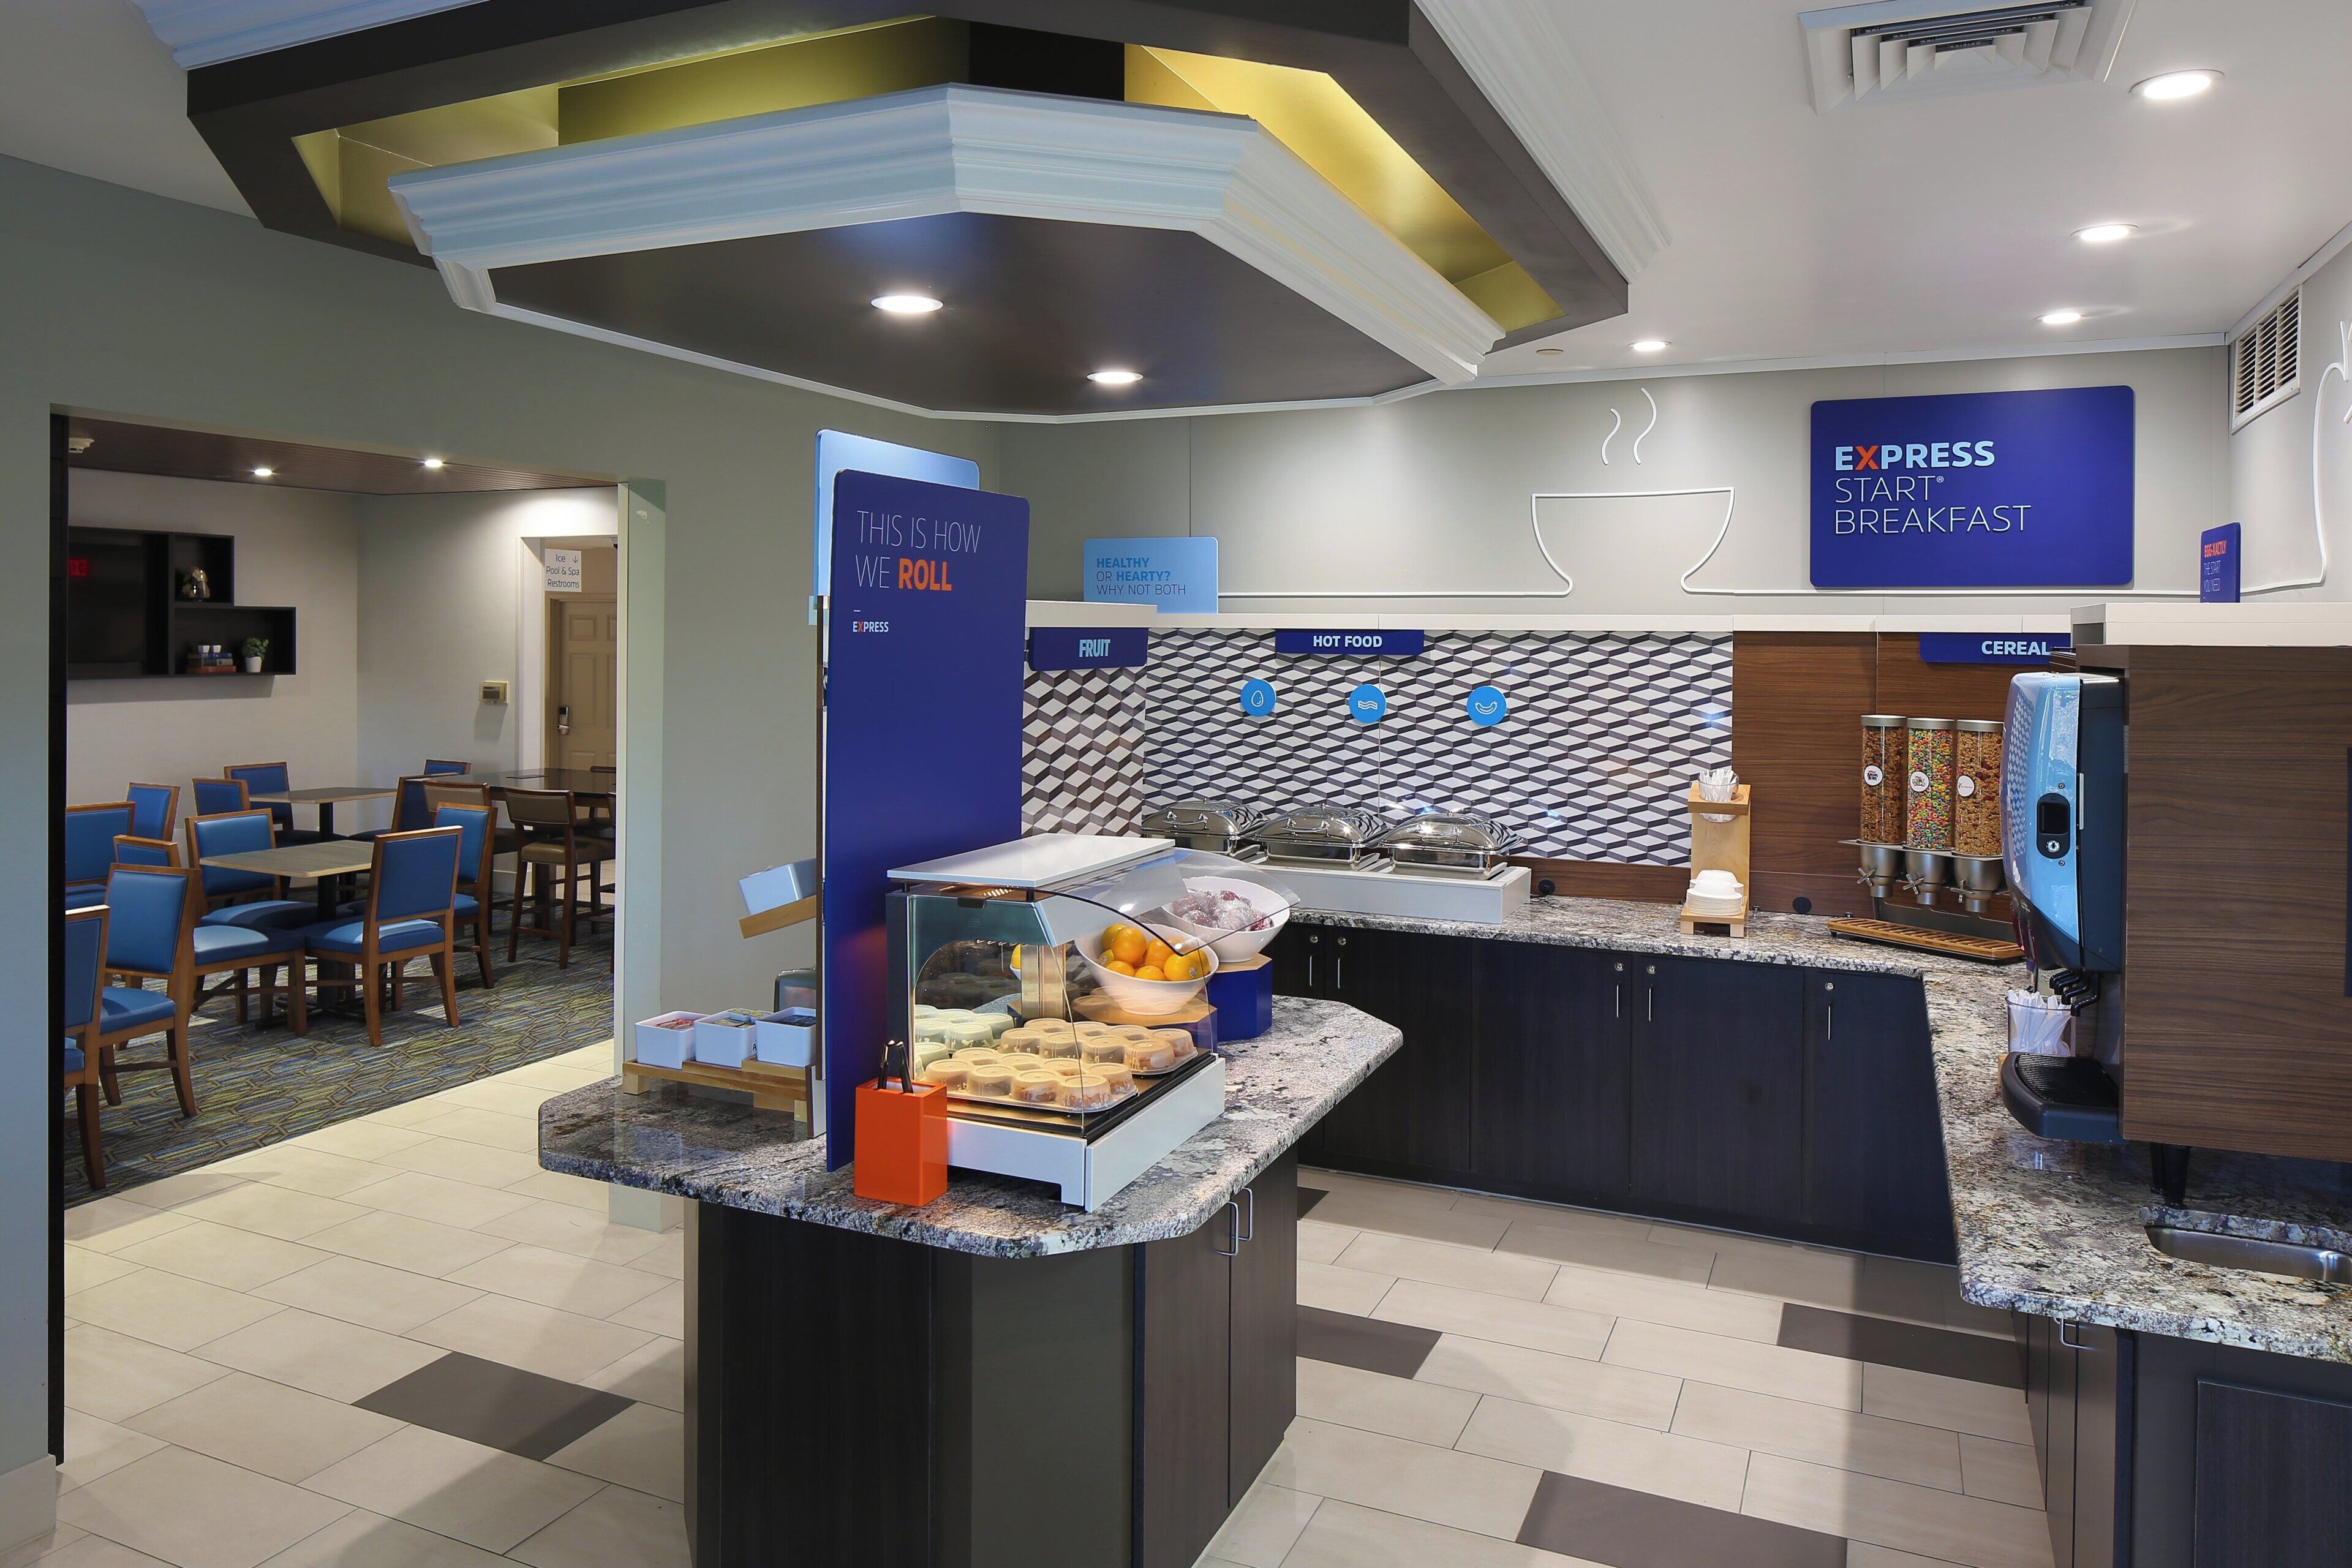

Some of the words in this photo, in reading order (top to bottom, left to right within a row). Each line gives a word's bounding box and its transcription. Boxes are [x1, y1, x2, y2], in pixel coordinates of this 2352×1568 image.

[1835, 440, 1995, 471] EXPRESS
[1835, 505, 2032, 535] BREAKFAST
[857, 510, 902, 546] THIS
[911, 518, 926, 549] IS
[935, 520, 981, 553] HOW
[556, 554, 565, 562] Ice
[1096, 557, 1150, 568] HEALTHY
[546, 566, 560, 575] Pool
[568, 567, 579, 576] Spa
[856, 555, 891, 588] WE
[899, 558, 952, 591] ROLL
[1096, 571, 1112, 581] OR
[1116, 570, 1170, 581] HEARTY?
[548, 579, 579, 588] Restrooms
[1096, 584, 1124, 595] WHY
[1128, 584, 1151, 595] NOT
[1155, 584, 1186, 595] BOTH
[853, 621, 889, 633] EXPRESS
[1313, 635, 1341, 647] HOT
[1344, 636, 1382, 648] FOOD
[1079, 639, 1110, 657] FRUIT
[1981, 641, 2051, 656] CEREAL
